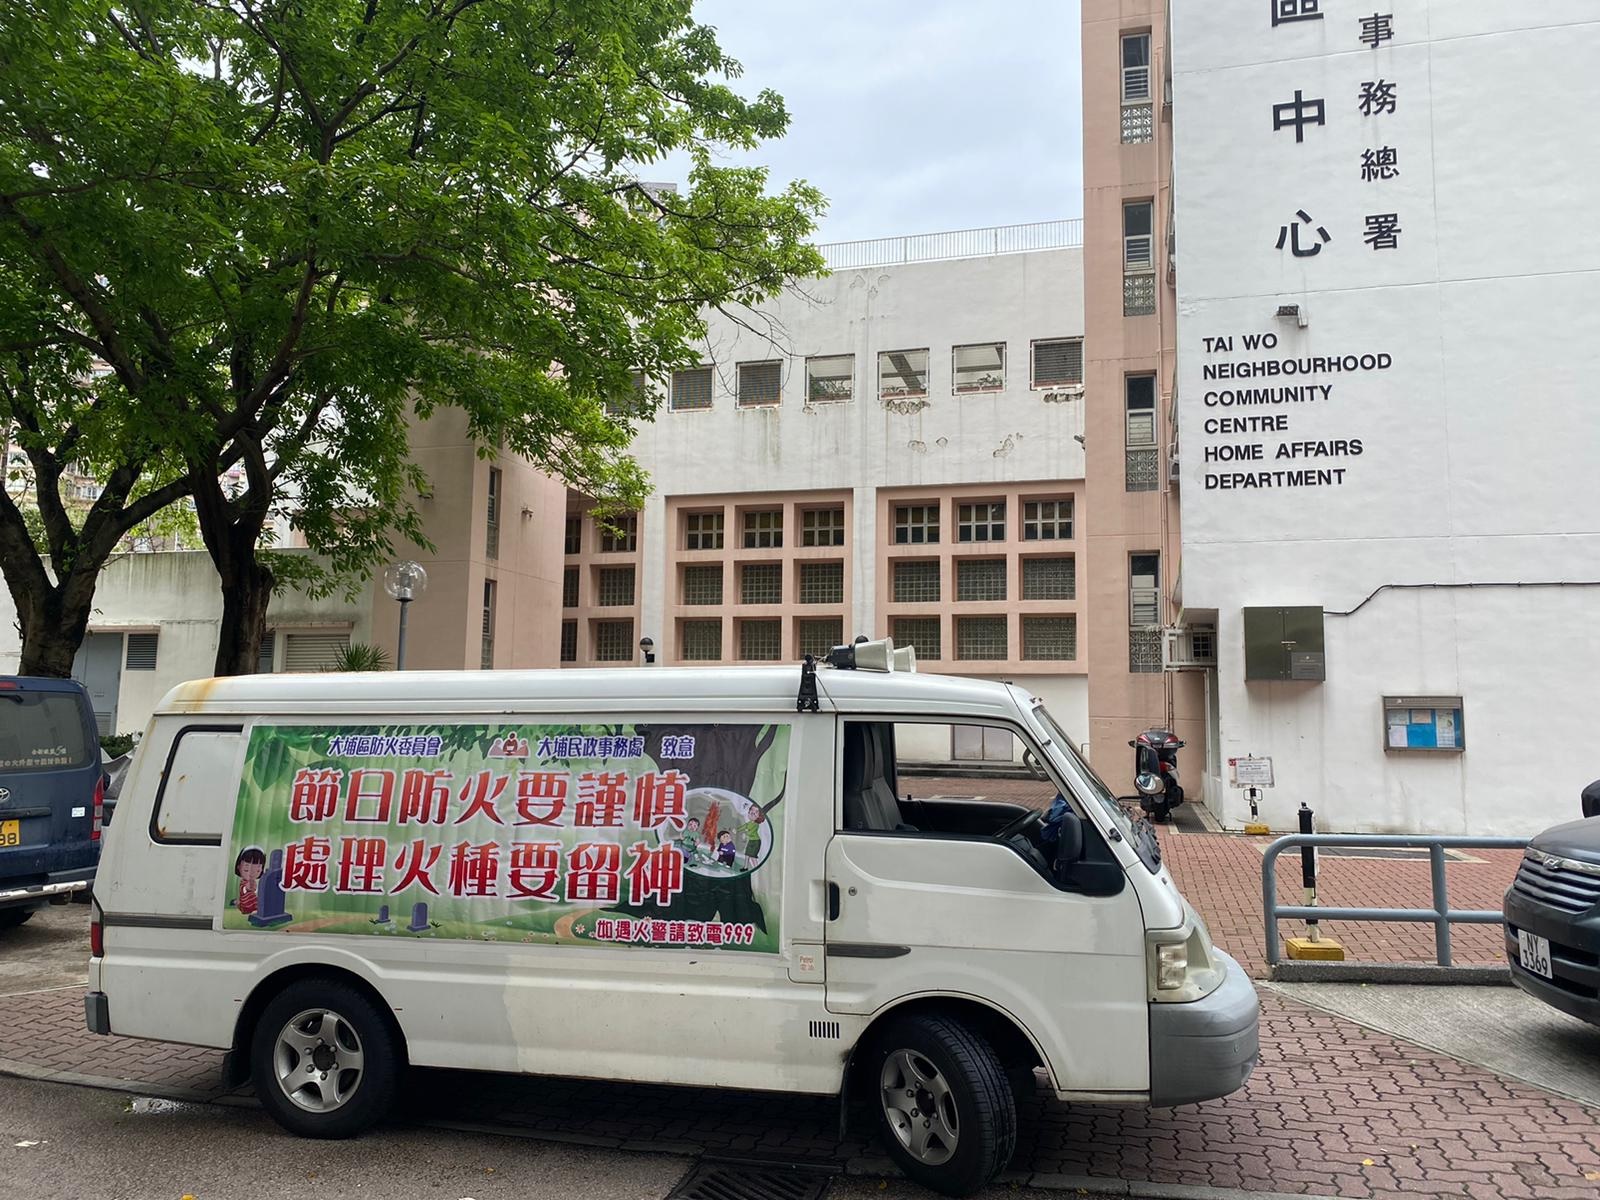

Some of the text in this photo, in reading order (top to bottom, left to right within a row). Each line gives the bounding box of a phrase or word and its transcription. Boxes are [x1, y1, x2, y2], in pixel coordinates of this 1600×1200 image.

[1358, 12, 1403, 251] 事務總署
[1202, 332, 1279, 353] TAI WO
[1203, 353, 1393, 381] NEIGHBOURHOOD
[1204, 384, 1333, 408] COMMUNITY
[1204, 414, 1289, 435] CENTRE
[1204, 438, 1364, 463] HOME AFFAIRS
[1204, 467, 1347, 490] DEPARTMENT
[327, 735, 696, 759] 大埔區防火委員會 大埔民政事務處 致意
[289, 769, 686, 829] 節日防火要謹慎
[281, 836, 684, 904] 處理火種要留神
[595, 918, 755, 945] 如遇火警請致電999
[1526, 933, 1539, 954] NY
[1522, 949, 1548, 976] 3369
